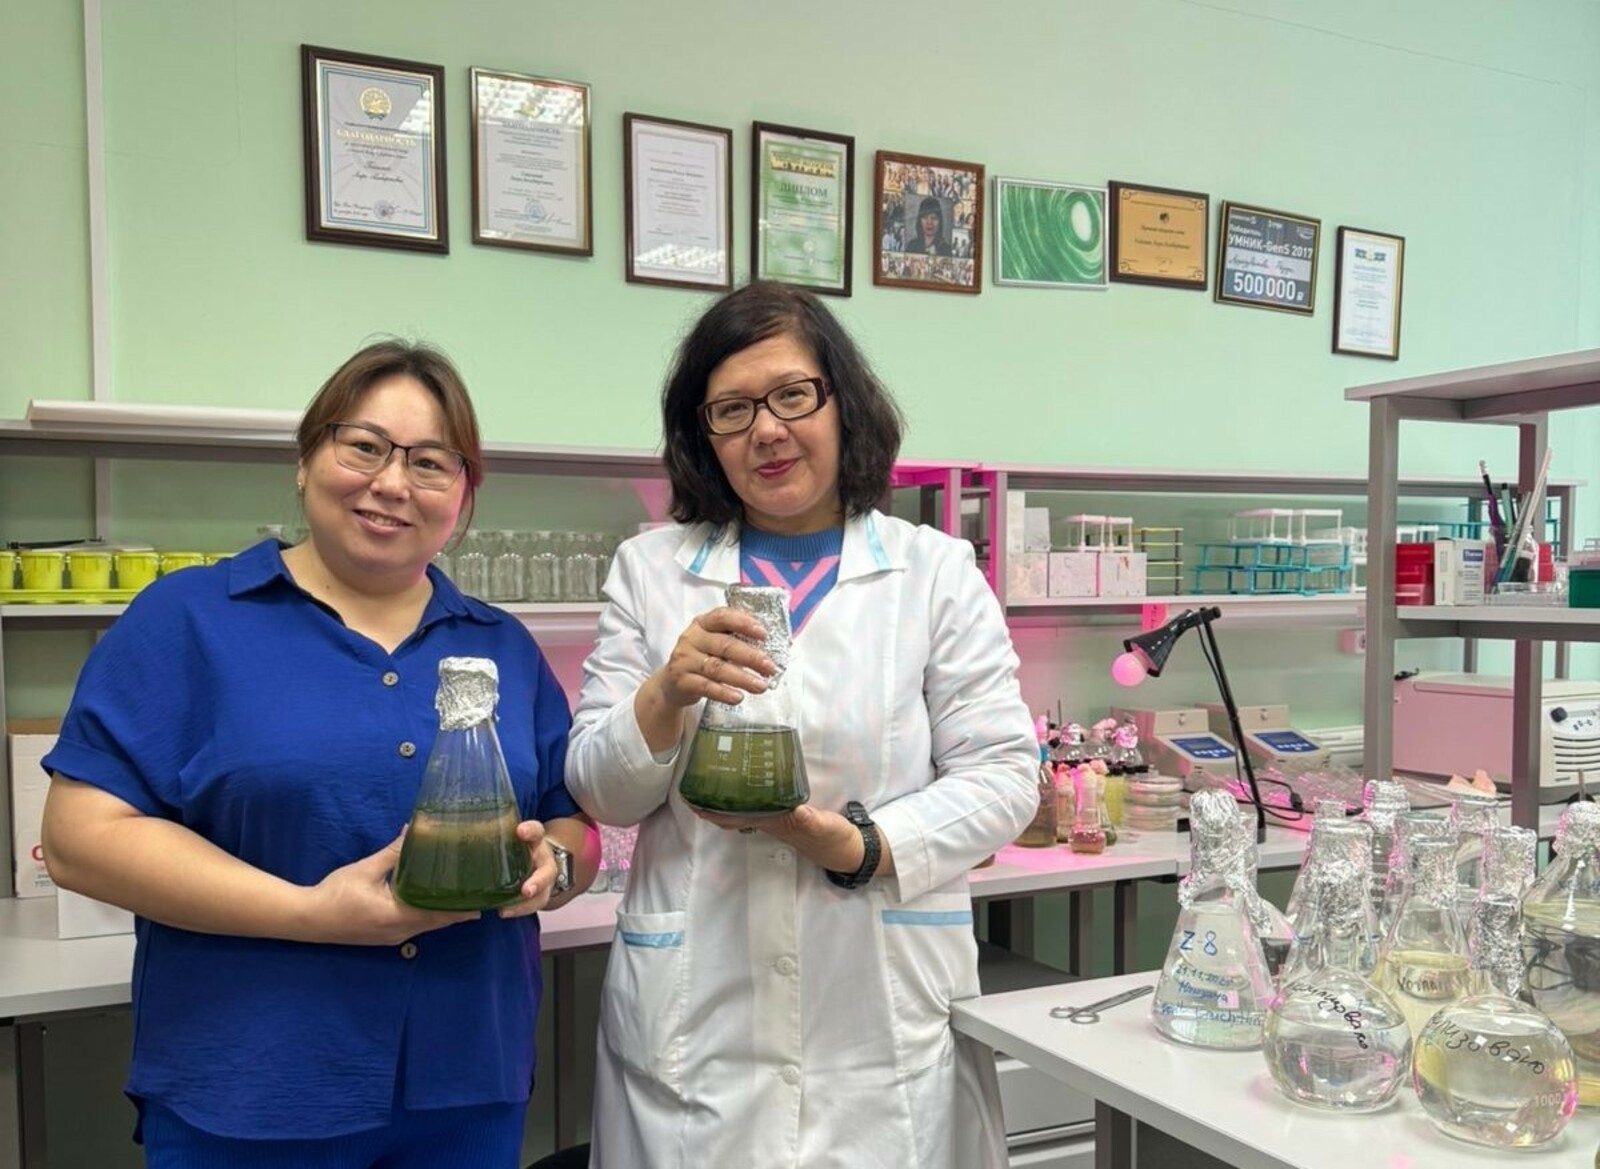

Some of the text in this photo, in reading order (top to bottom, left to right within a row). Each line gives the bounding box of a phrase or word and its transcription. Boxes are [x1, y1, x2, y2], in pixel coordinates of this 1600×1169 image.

[779, 182, 828, 198] ДИПЛОМ
[1291, 244, 1313, 259] 2017
[1233, 272, 1264, 295] 500
[1266, 277, 1296, 300] 000
